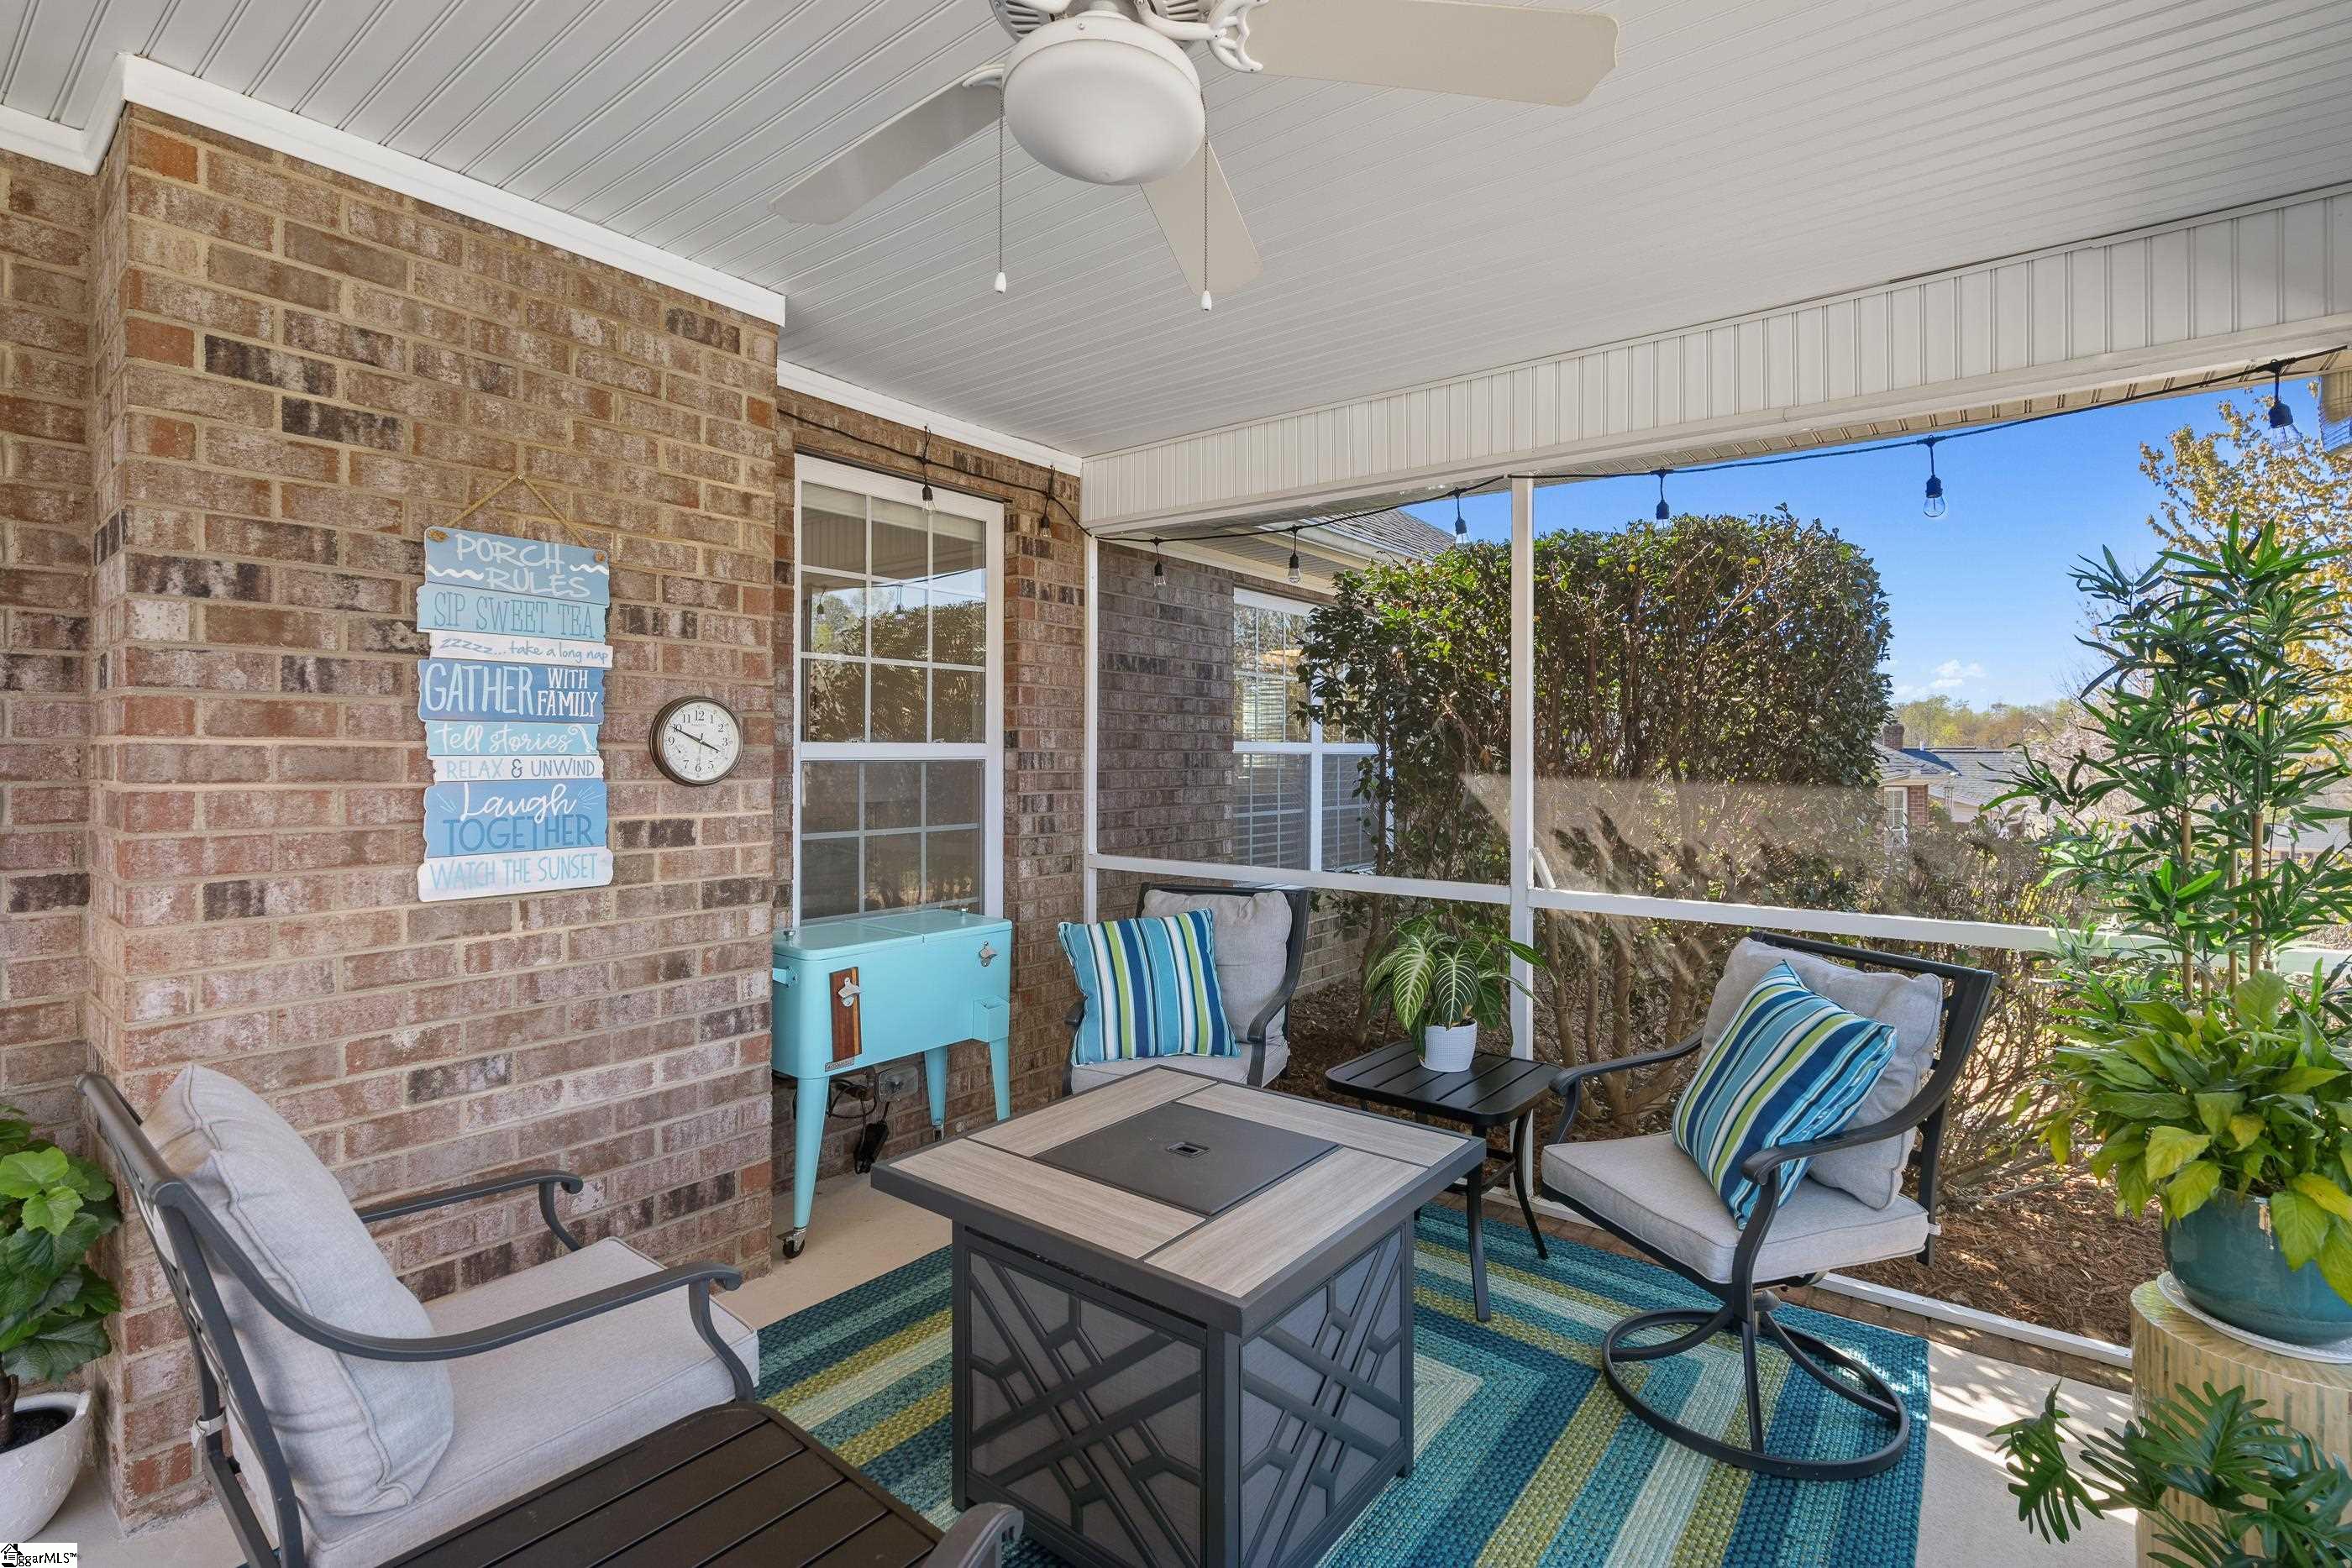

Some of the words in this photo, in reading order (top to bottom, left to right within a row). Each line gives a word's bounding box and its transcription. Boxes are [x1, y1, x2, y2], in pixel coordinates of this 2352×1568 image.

[455, 534, 565, 574] PORCH
[485, 567, 591, 597] RULES
[434, 591, 466, 627] SIP
[475, 595, 549, 633] SWEET
[557, 604, 596, 639] TEA
[510, 640, 543, 656] take
[546, 648, 556, 658] a
[559, 642, 582, 663] long
[586, 650, 608, 664] nap
[425, 663, 533, 715] GATHER
[548, 668, 589, 689] WITH
[537, 690, 598, 717] FAMILY
[694, 711, 705, 721] 12
[489, 724, 573, 753] stories
[668, 737, 675, 746] 9
[717, 724, 724, 732] 2
[722, 737, 728, 747] 3
[446, 759, 504, 779] RELAX
[511, 758, 523, 779] &
[531, 758, 595, 777] UNWIND
[695, 762, 702, 773] 6
[460, 782, 577, 825] Laugh
[443, 814, 594, 855] TOGETHER
[430, 861, 496, 890] WATCH
[504, 857, 531, 885] THE
[538, 852, 598, 881] SUNSET
